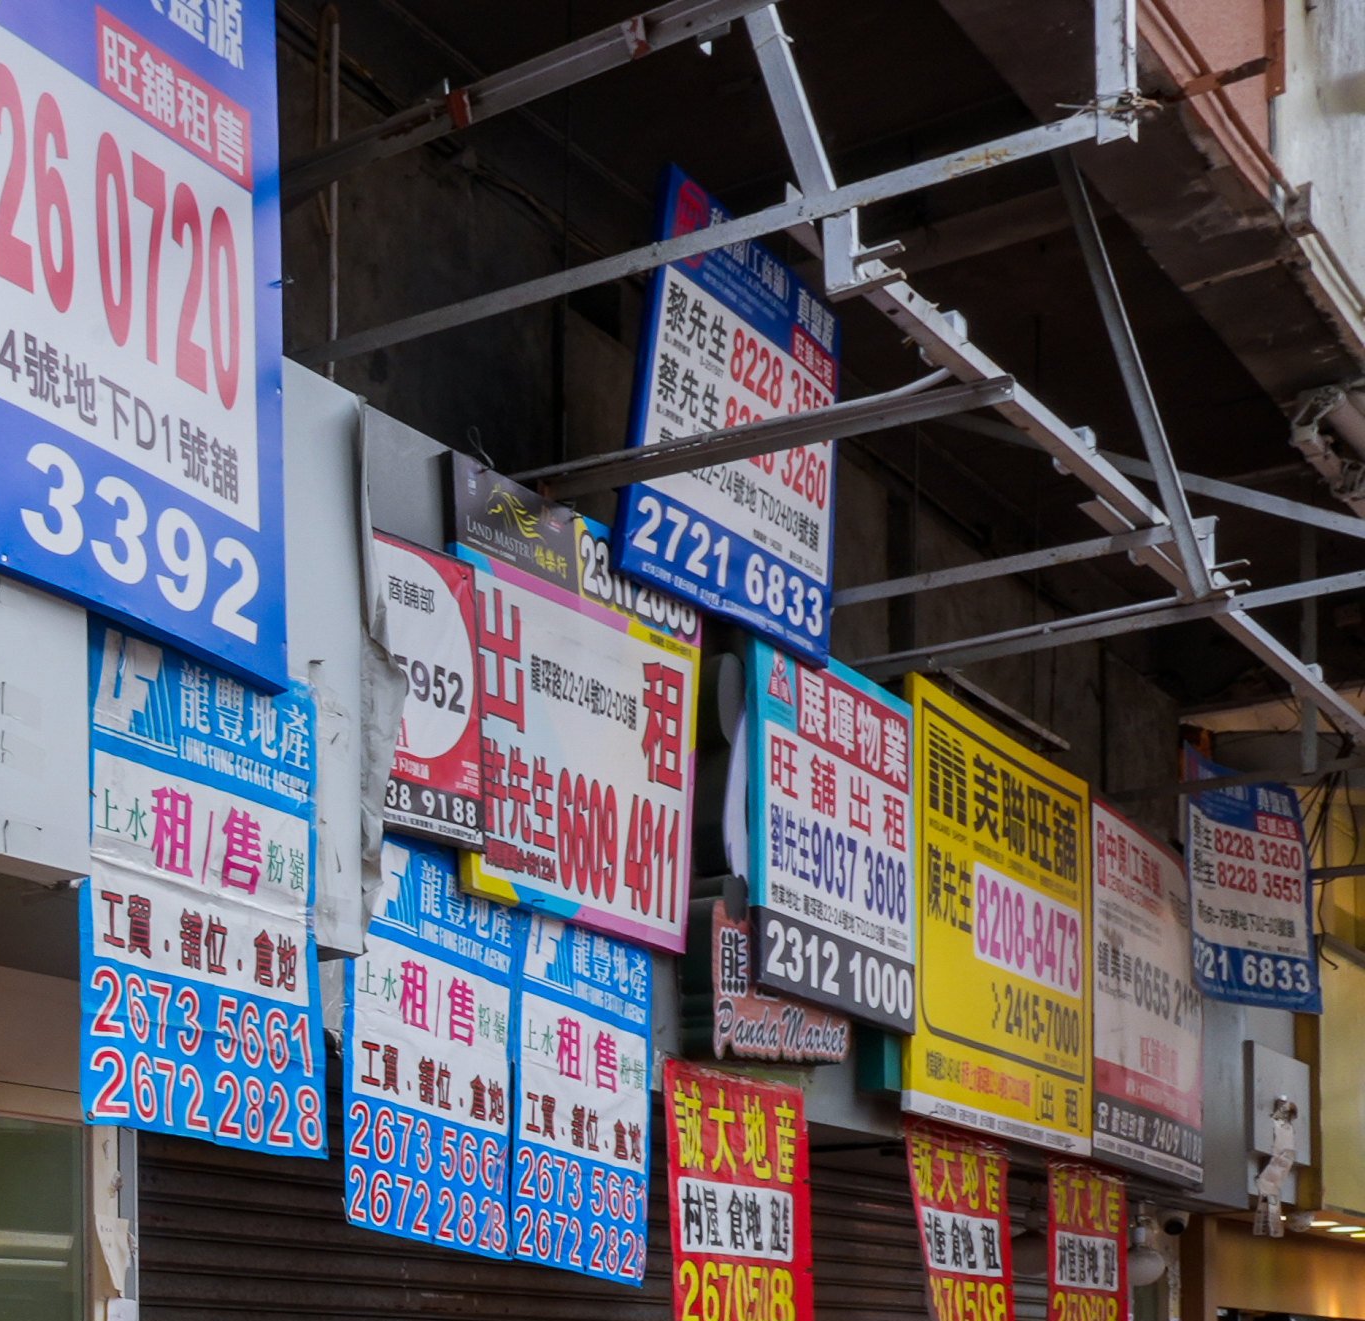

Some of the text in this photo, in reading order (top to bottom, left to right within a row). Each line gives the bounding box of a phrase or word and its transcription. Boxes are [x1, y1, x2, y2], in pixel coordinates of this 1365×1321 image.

[96, 131, 240, 411] 0720
[730, 327, 783, 410] 8228
[781, 436, 827, 511] 3260
[20, 443, 260, 644] 3392
[633, 494, 732, 588] 2721
[744, 553, 825, 638] 6833
[477, 586, 526, 733] 出
[641, 660, 684, 792] 租
[798, 670, 909, 787] 展暉物業
[97, 788, 148, 842] 上水
[421, 792, 477, 828] 9188
[771, 733, 907, 854] 旺舖出租
[557, 766, 619, 904] 6609
[624, 793, 681, 924] 4811
[811, 821, 859, 903] 9037
[864, 846, 907, 926] 3608
[1214, 828, 1302, 872] 8228 3260
[1217, 861, 1303, 905] 8228 3553
[767, 918, 914, 1021] 2312 1000
[977, 873, 1080, 993] 8208-8473
[1242, 954, 1311, 993] 6833
[91, 965, 314, 1078] 2673 5661
[716, 998, 849, 1062] Panda Market
[1004, 983, 1080, 1063] 2415-7000
[92, 1046, 324, 1150] 2672 2828
[350, 1101, 431, 1174] 2673
[350, 1167, 509, 1254] 2672 2828
[517, 1147, 583, 1207] 2673
[682, 1183, 764, 1253] 村屋 倉地
[515, 1209, 583, 1267] 2672
